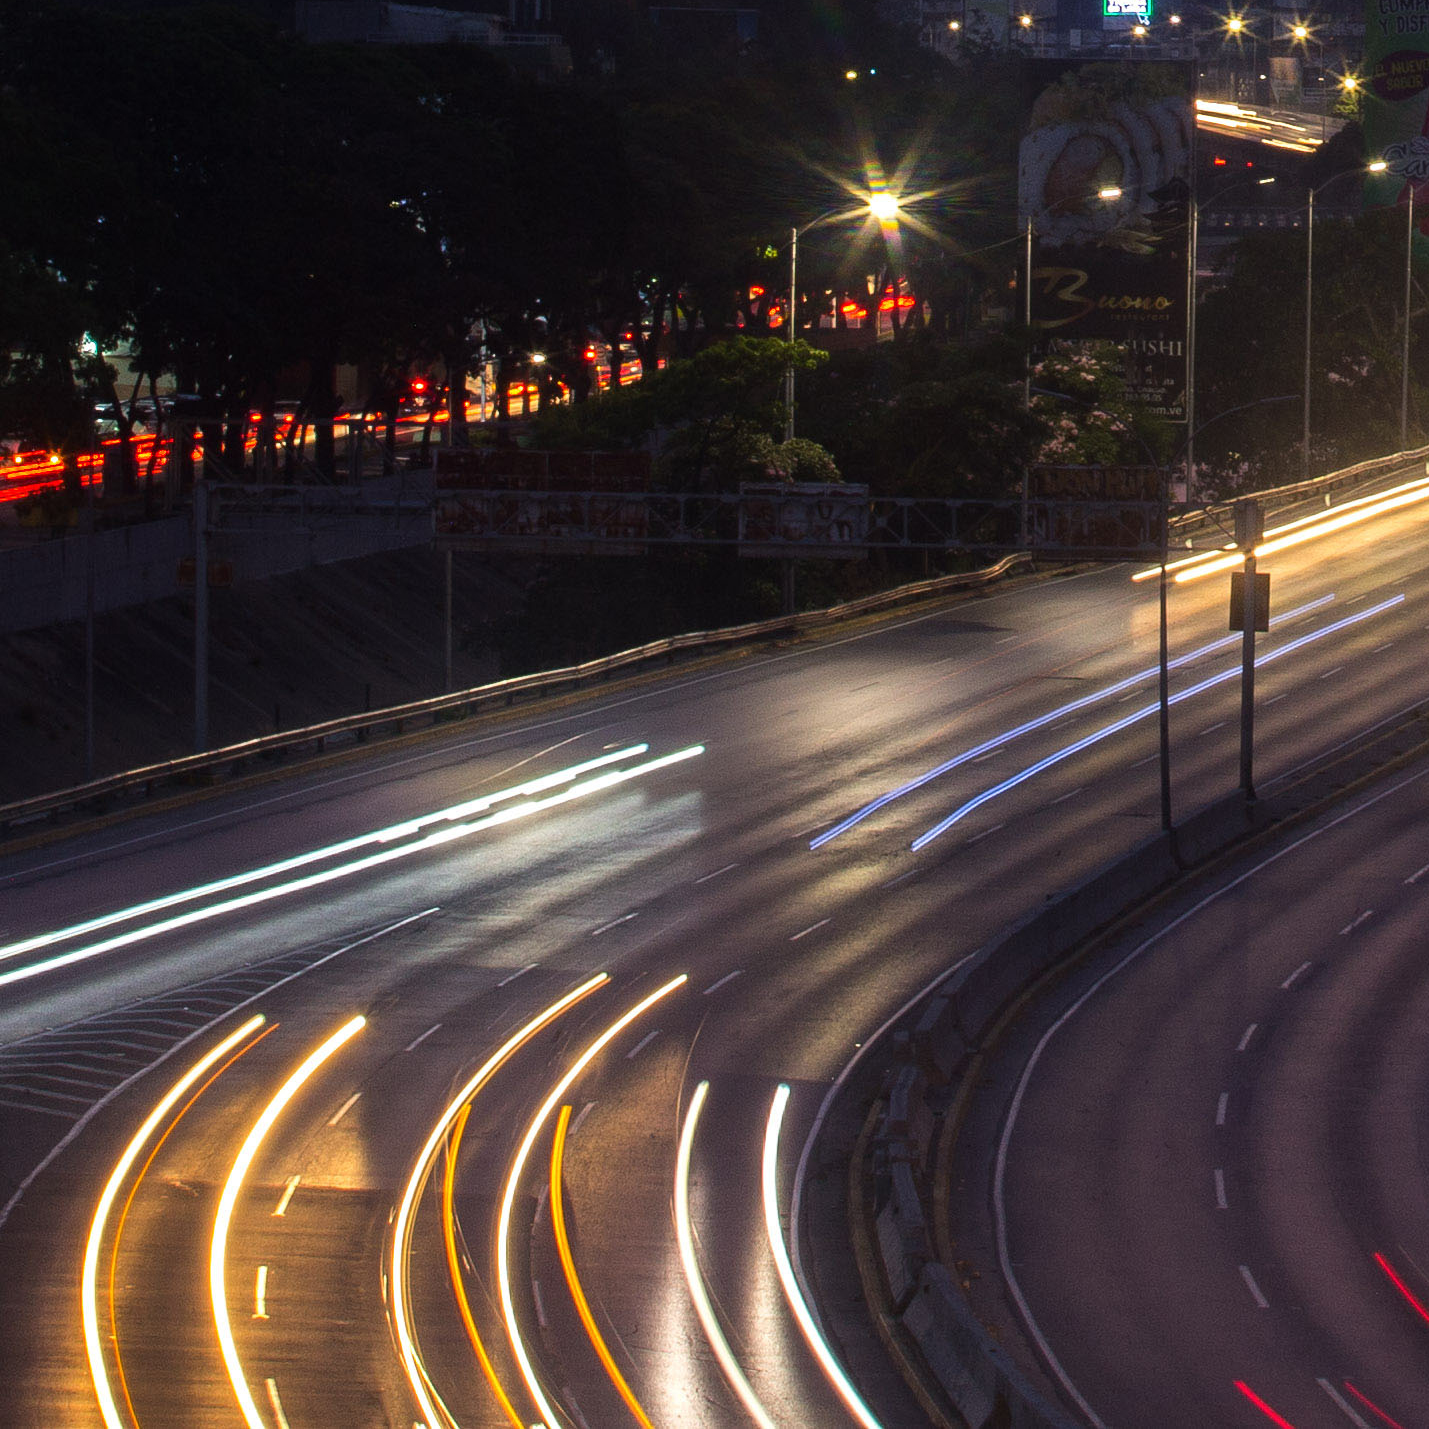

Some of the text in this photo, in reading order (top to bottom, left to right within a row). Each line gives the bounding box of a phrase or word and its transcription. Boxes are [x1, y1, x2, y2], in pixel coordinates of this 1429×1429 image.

[1379, 18, 1388, 35] Y
[1386, 75, 1424, 91] SABOR
[1031, 267, 1175, 328] Buono
[1123, 339, 1182, 357] SUSHI
